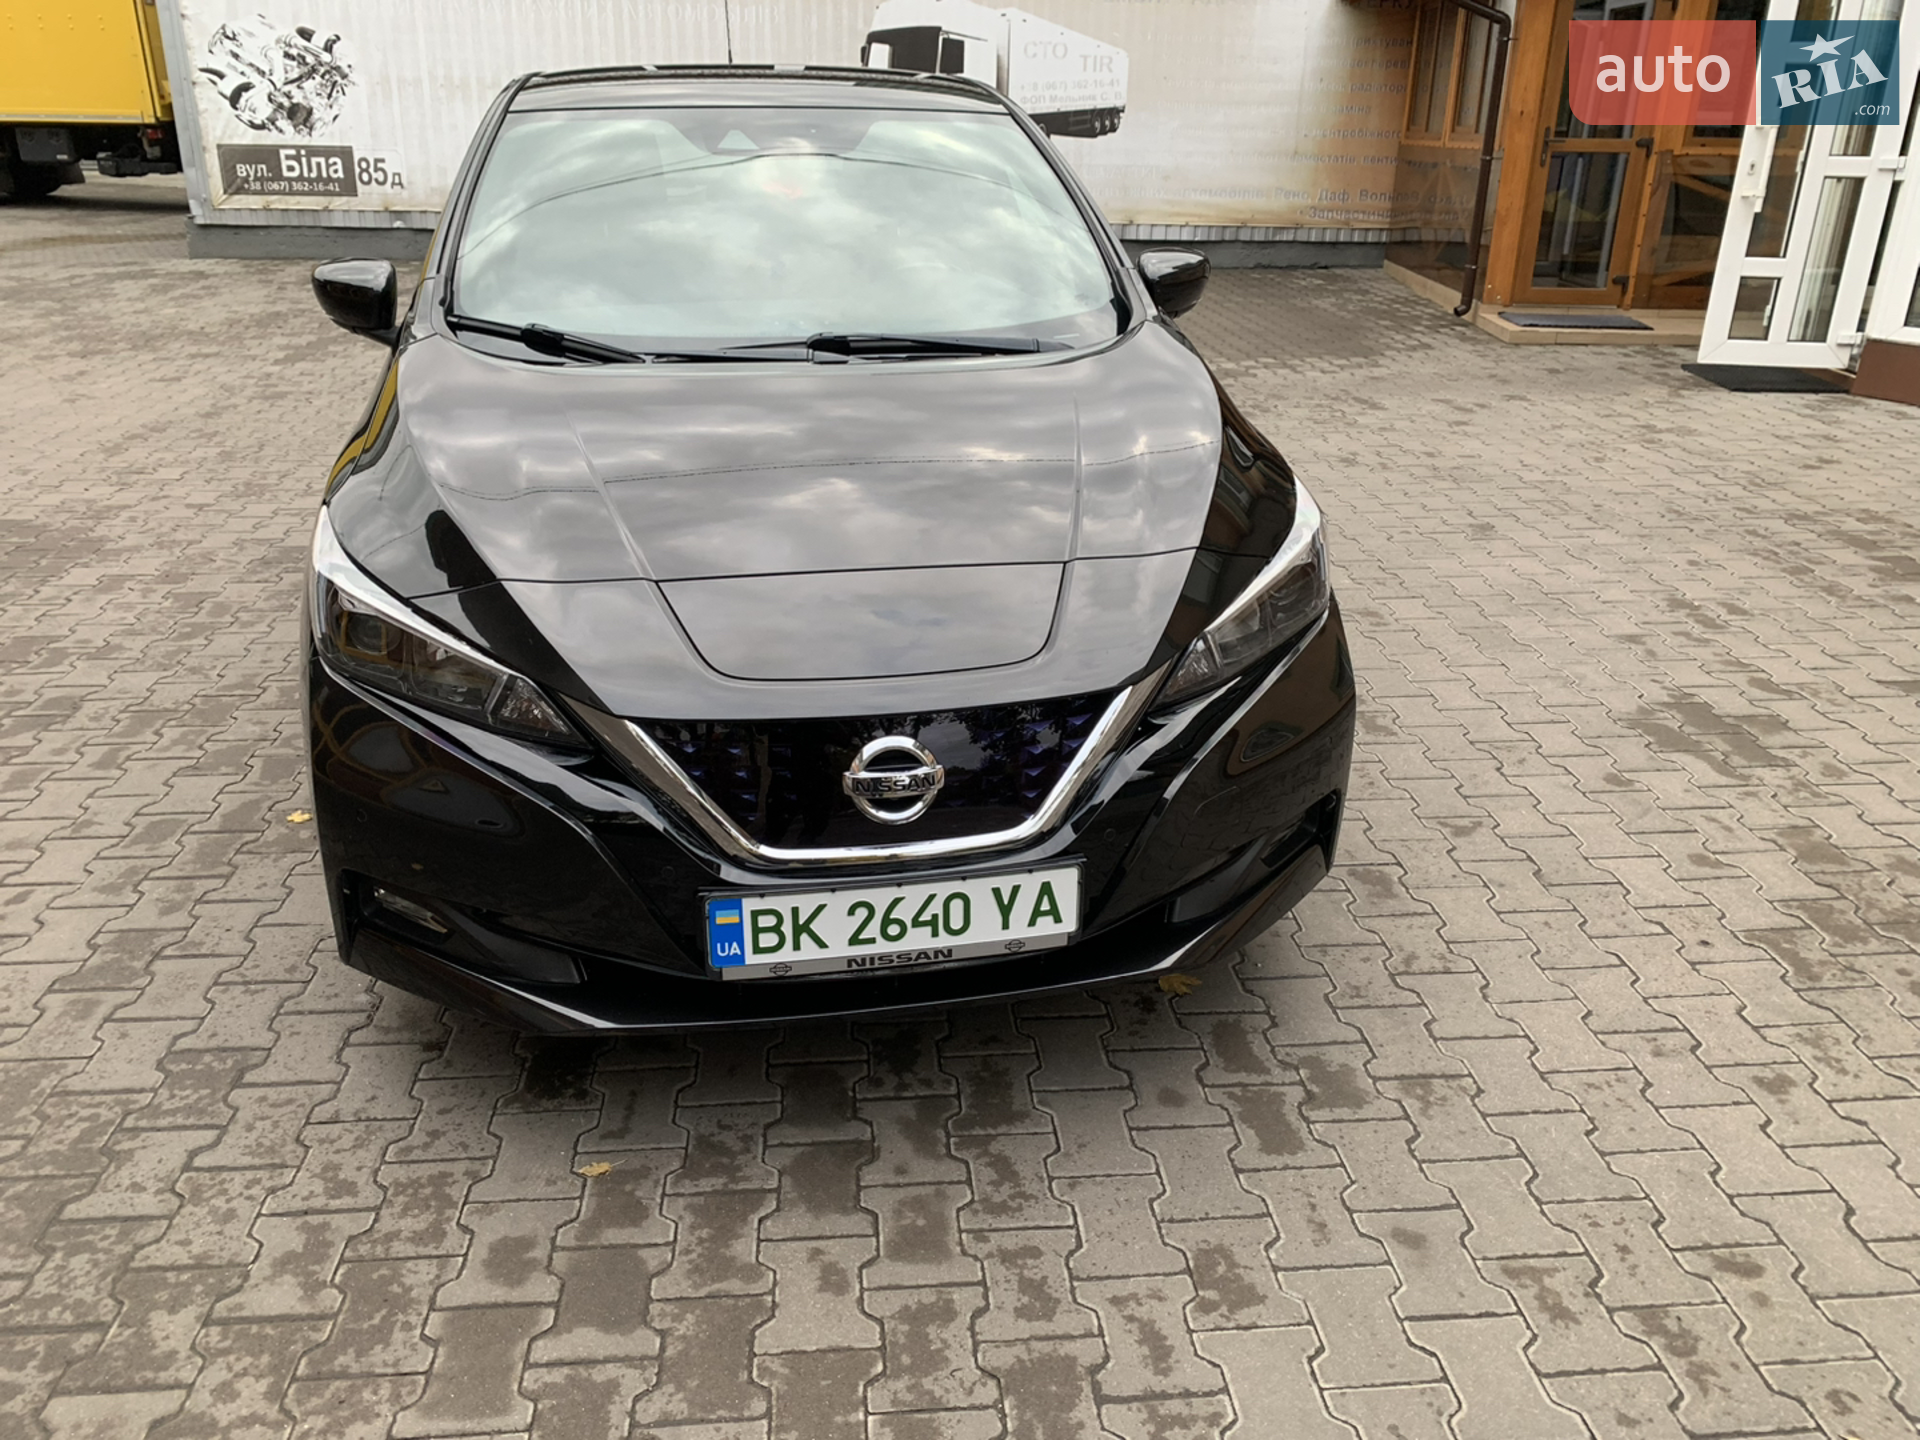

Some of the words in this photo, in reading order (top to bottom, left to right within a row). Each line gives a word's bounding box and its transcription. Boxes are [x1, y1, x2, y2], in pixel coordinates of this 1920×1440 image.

[1079, 54, 1114, 73] TIR
[236, 163, 272, 181] вул.
[279, 148, 345, 179] Біла
[243, 181, 261, 191] +38
[263, 181, 290, 193] (067)
[291, 181, 341, 192] 362-16-41
[855, 774, 936, 794] NISSAN
[750, 903, 829, 955] BK
[846, 891, 972, 947] 2640
[991, 880, 1064, 931] YA
[716, 941, 742, 958] UA
[846, 947, 953, 969] NISSAN
